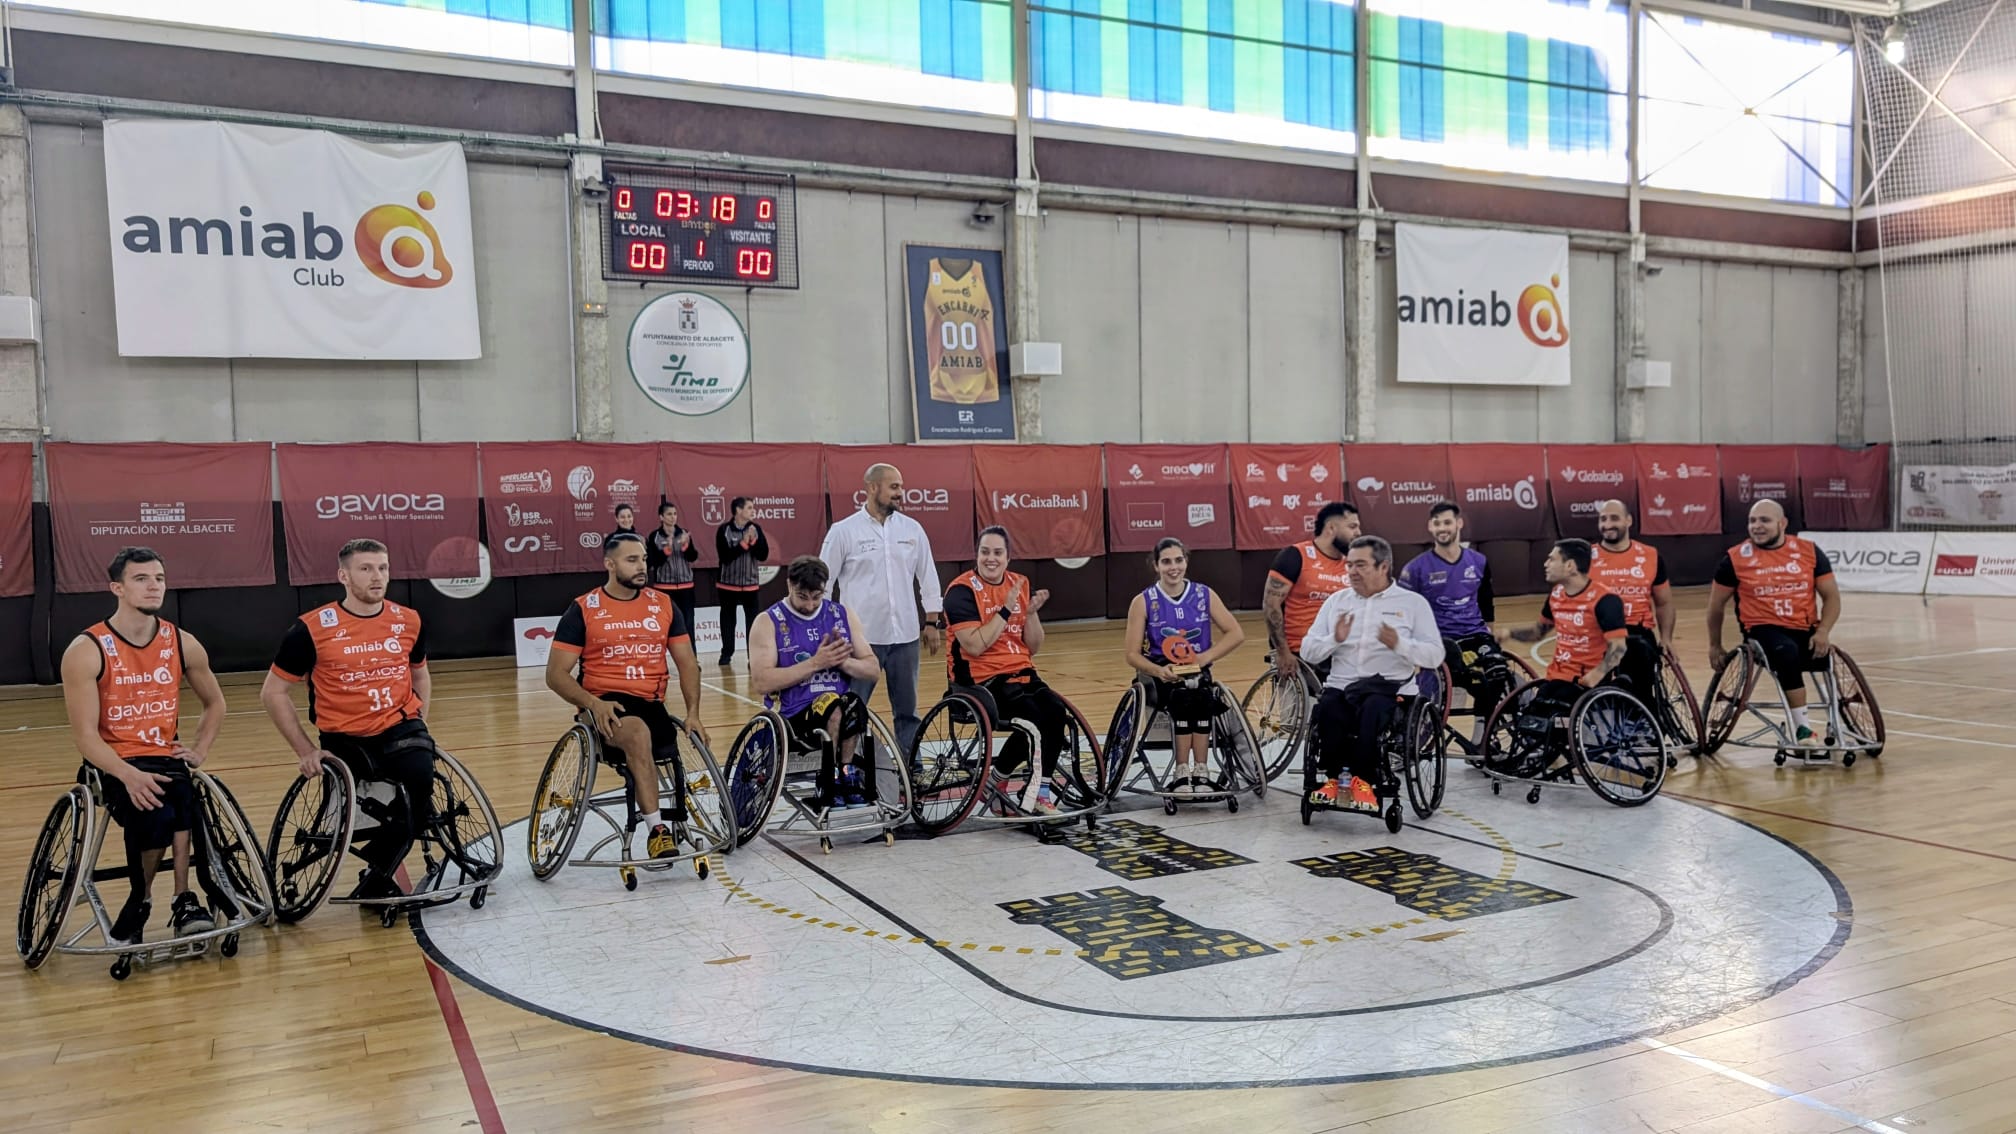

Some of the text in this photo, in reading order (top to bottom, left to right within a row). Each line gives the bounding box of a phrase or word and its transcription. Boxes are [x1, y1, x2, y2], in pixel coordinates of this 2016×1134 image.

[618, 190, 631, 209] 0
[656, 191, 736, 222] 03:18
[759, 201, 771, 219] 0
[122, 205, 344, 261] amiab
[621, 223, 665, 238] LOCAL
[730, 230, 771, 244] VISITANTE
[630, 243, 665, 269] 00
[698, 240, 704, 256] 1
[683, 260, 714, 271] PERIODO
[738, 250, 772, 276] 00
[293, 268, 345, 287] Club
[1398, 289, 1511, 327] amiab
[643, 334, 691, 342] AYUNTAMIENTO
[942, 321, 977, 350] 00
[941, 355, 983, 368] AMIAB
[1577, 470, 1624, 486] Globalcaja
[1392, 482, 1436, 492] CASTILLA-
[1466, 484, 1512, 502] amiab
[316, 493, 445, 519] gaviota
[1019, 493, 1080, 509] CaixaBank
[1393, 495, 1445, 504] LA MANCHA
[91, 523, 236, 535] DIPUTACIÓN DE ALBACETE
[1136, 520, 1162, 528] UCLM
[1829, 550, 1921, 566] aviota
[604, 620, 641, 630] amiab
[807, 628, 820, 641] 55
[344, 641, 383, 654] amiab
[602, 643, 662, 658] gaviota
[115, 672, 152, 685] amiab
[368, 687, 394, 712] 33
